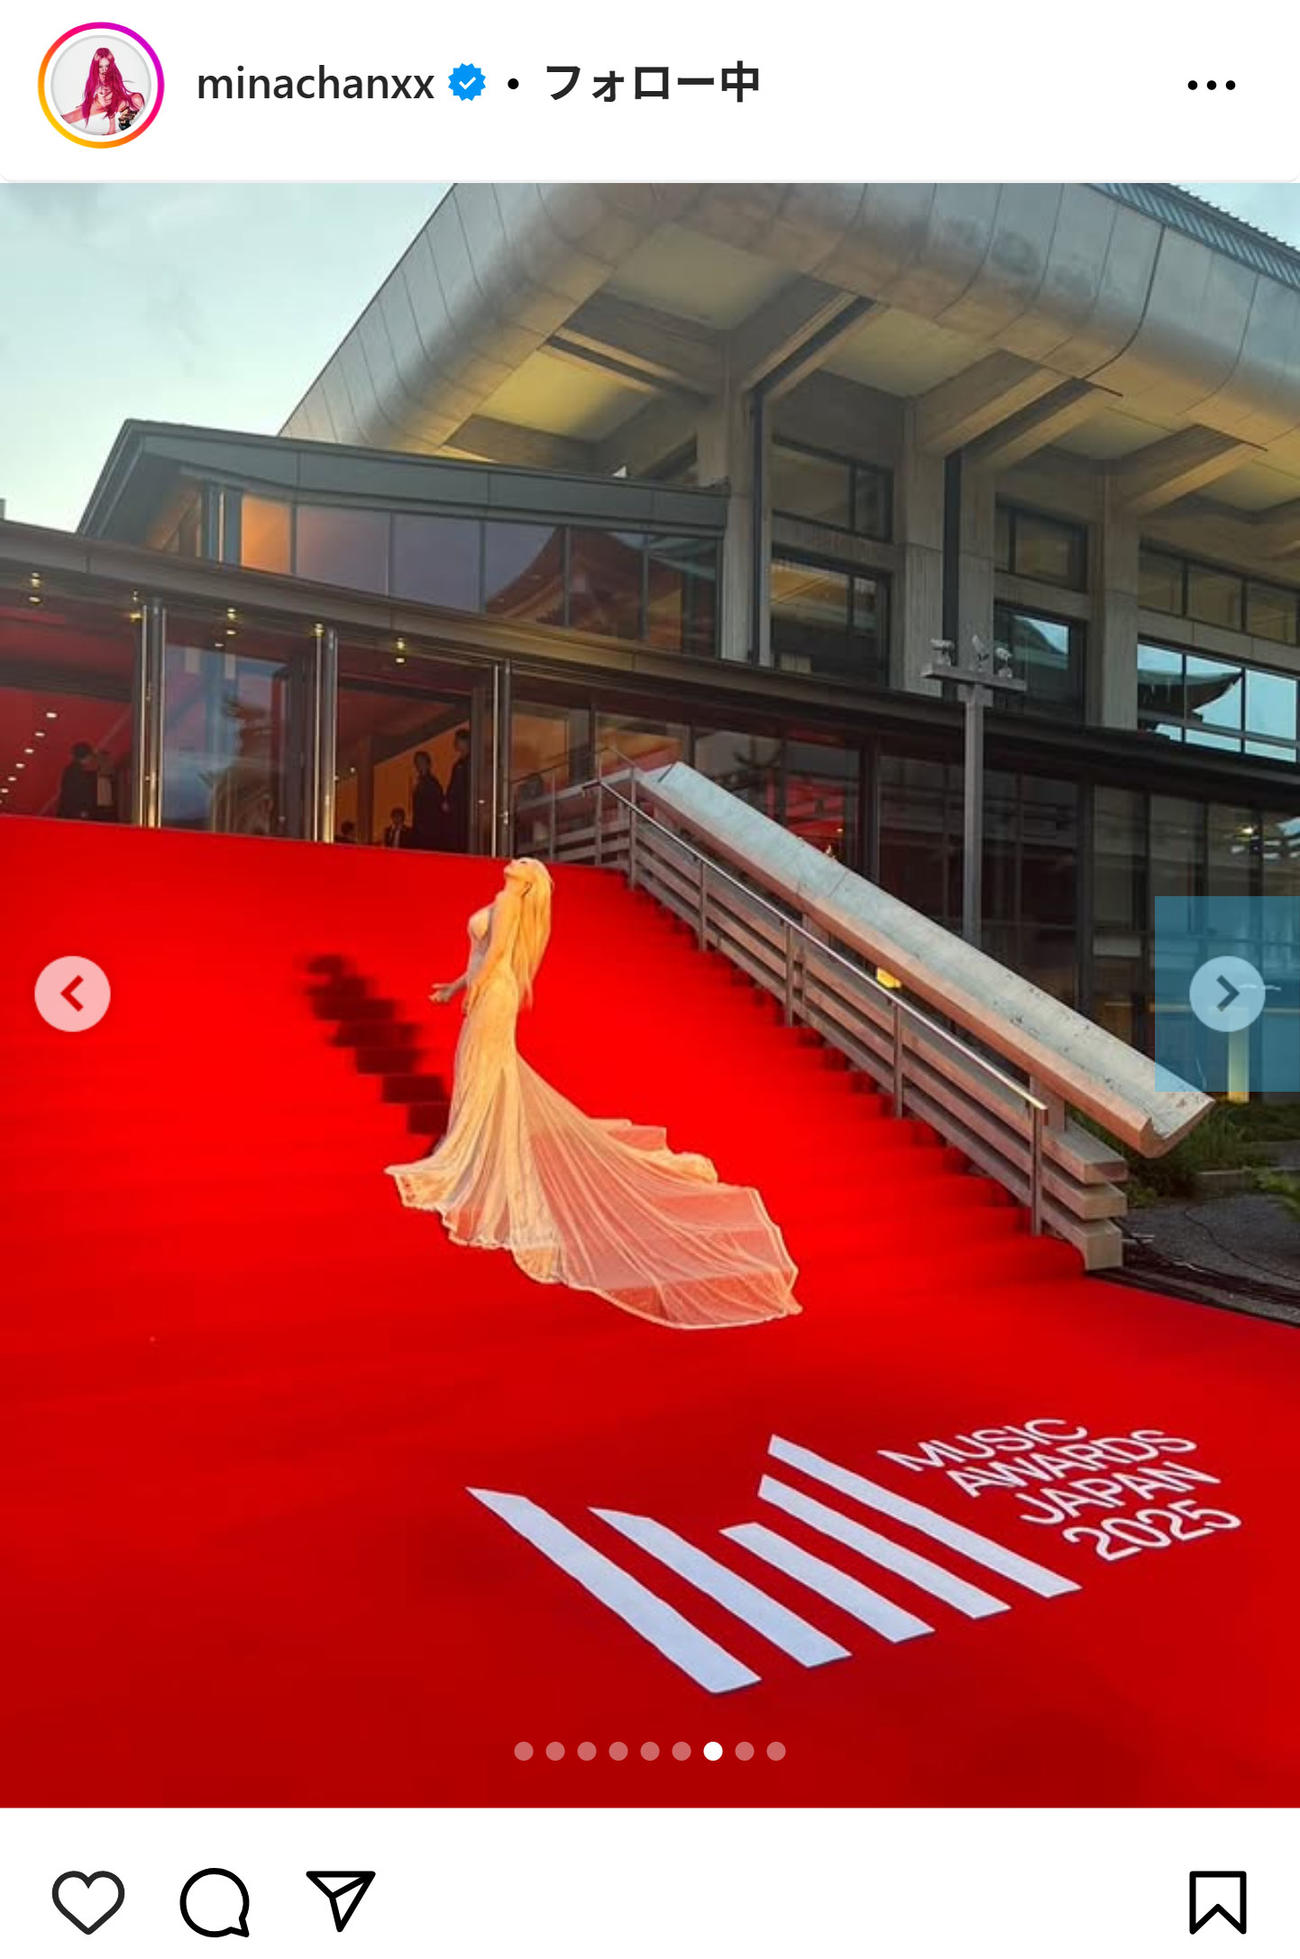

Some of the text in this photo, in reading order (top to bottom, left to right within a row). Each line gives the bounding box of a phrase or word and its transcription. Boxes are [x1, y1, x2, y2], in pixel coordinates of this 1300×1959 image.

[877, 1418, 1088, 1471] MUSIC
[945, 1429, 1197, 1497] AWARDS
[1014, 1461, 1221, 1525] JAPAN
[1062, 1499, 1242, 1561] 2025
